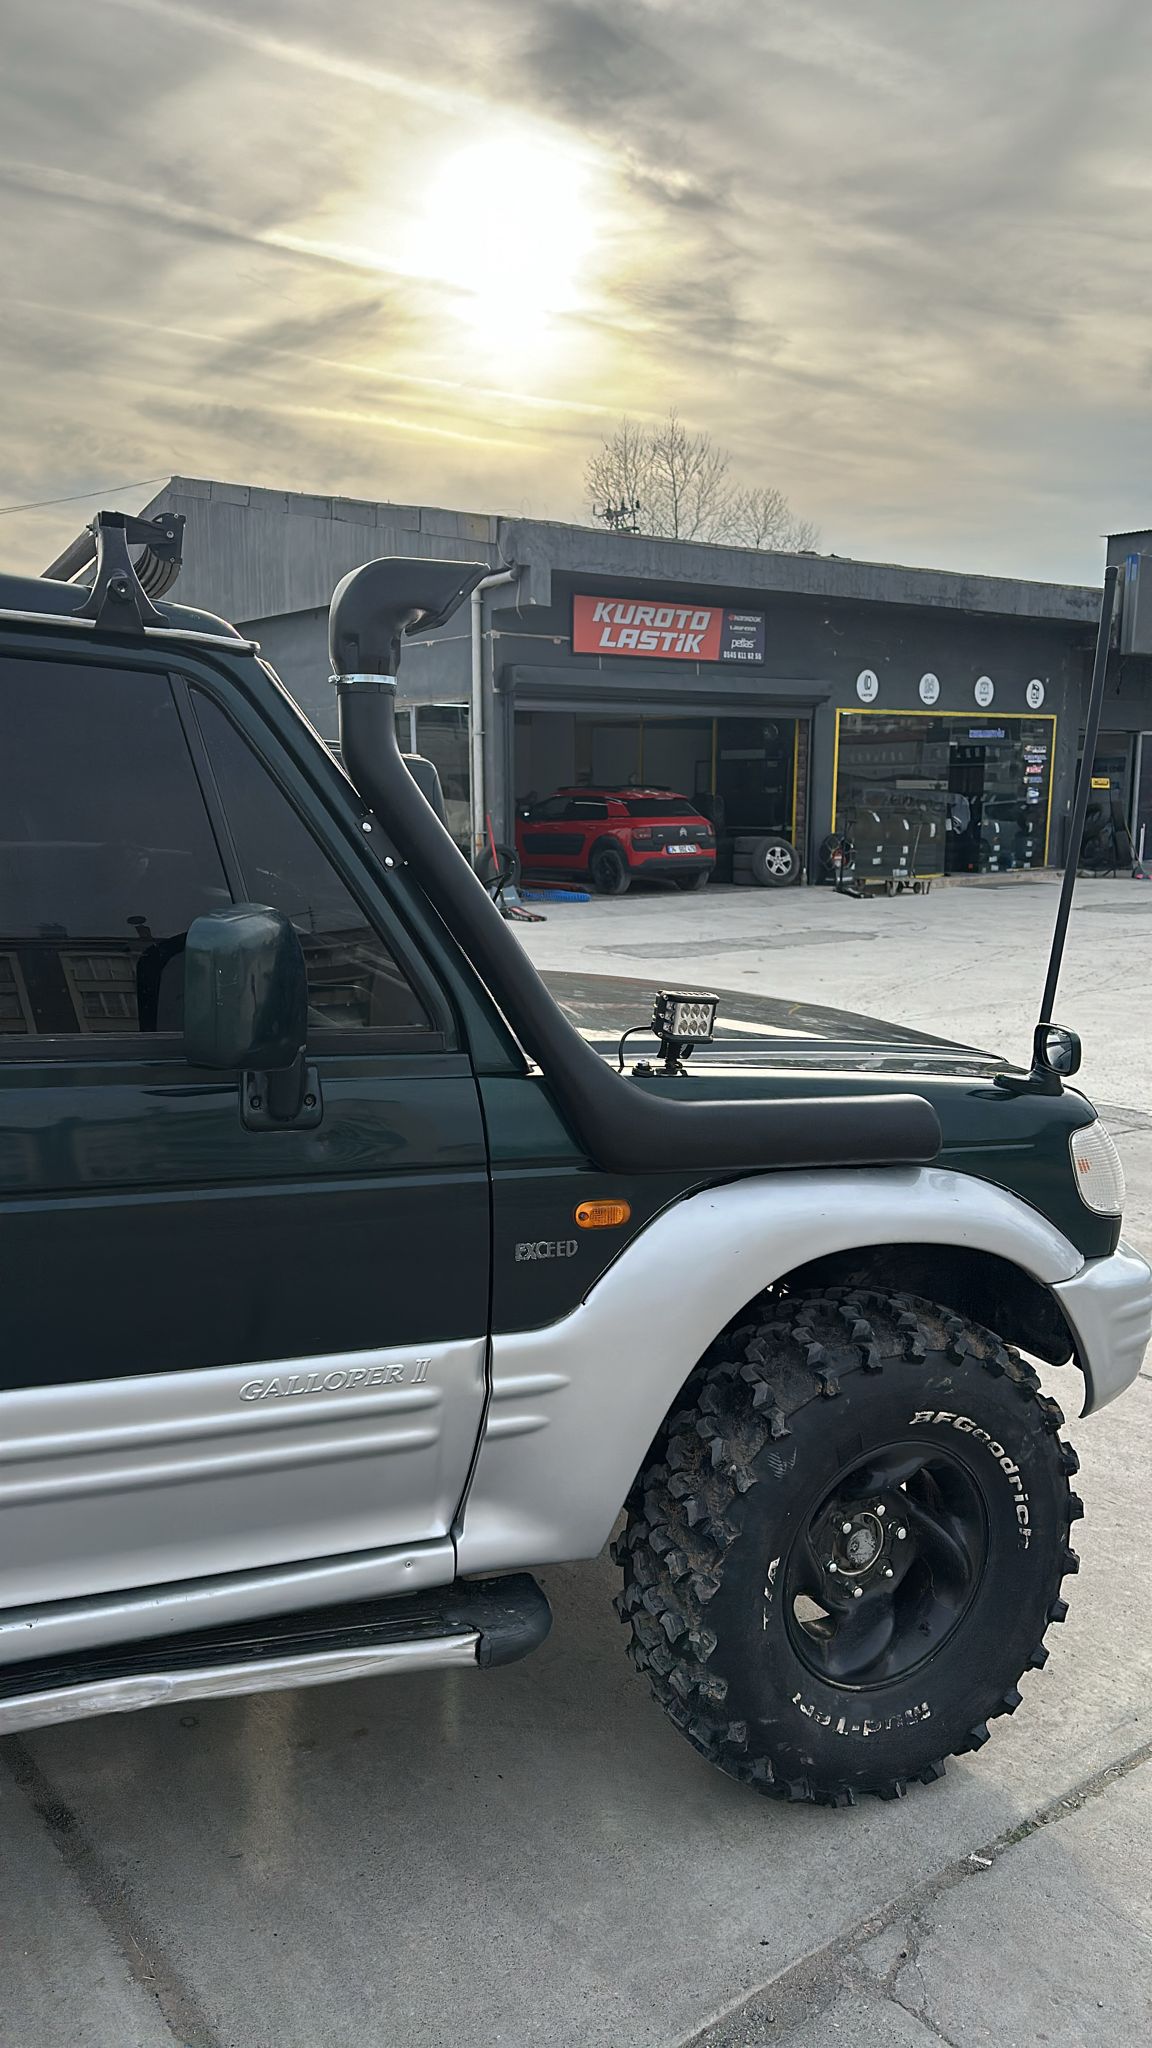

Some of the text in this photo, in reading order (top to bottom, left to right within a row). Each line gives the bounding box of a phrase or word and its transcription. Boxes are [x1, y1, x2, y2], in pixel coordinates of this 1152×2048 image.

[592, 602, 711, 631] KUROTO
[515, 1239, 578, 1262] EXCEED
[239, 1364, 404, 1401] GALLOPER
